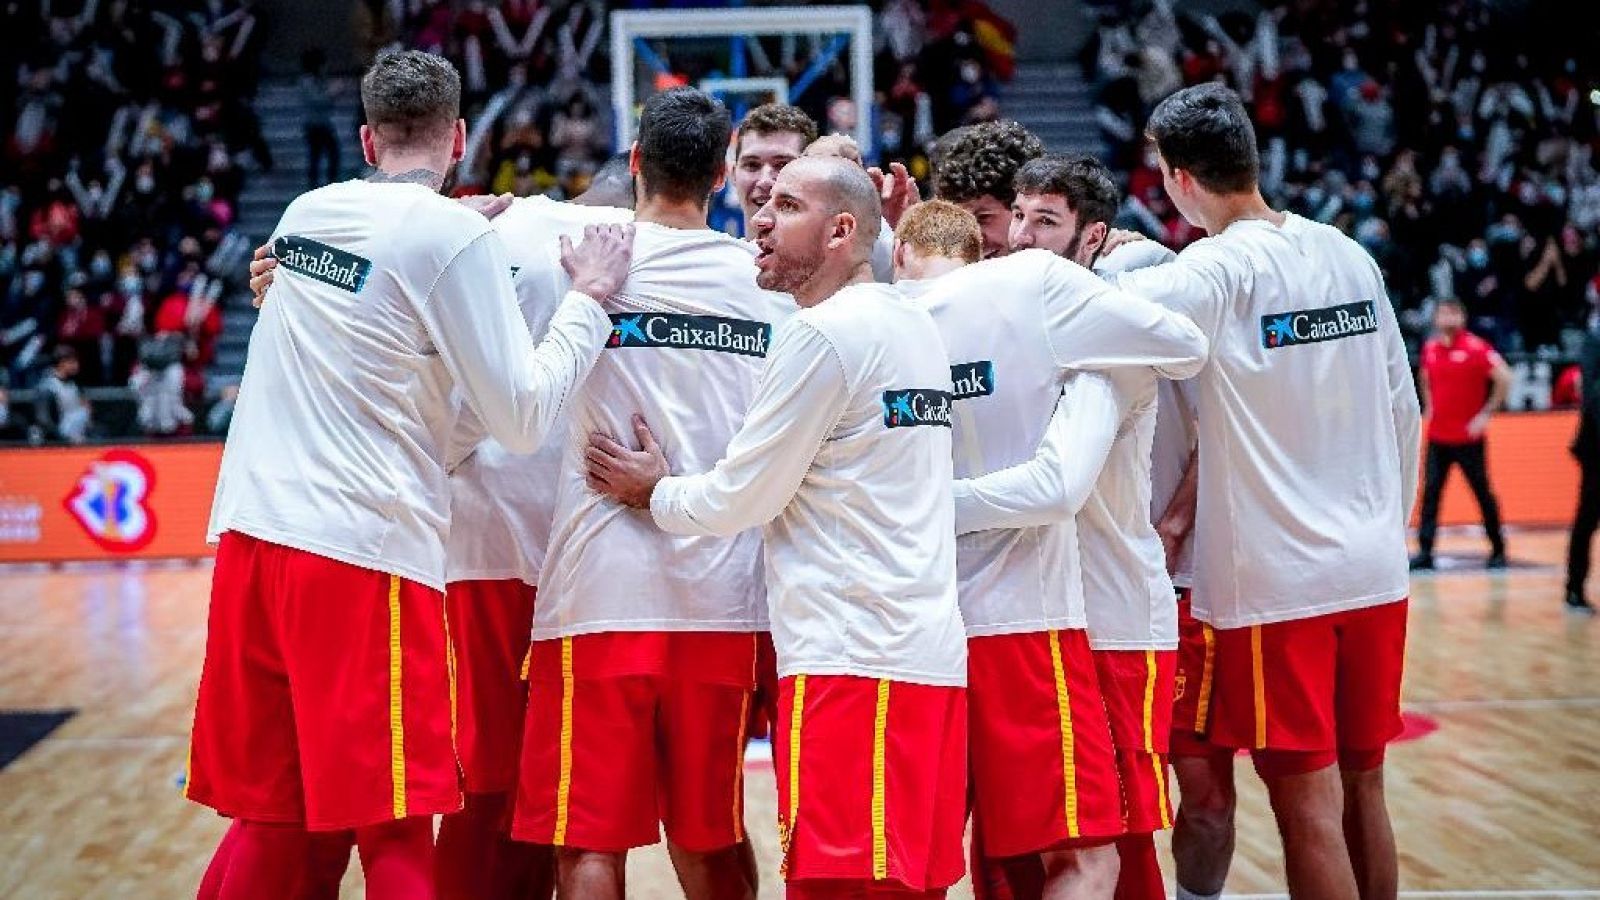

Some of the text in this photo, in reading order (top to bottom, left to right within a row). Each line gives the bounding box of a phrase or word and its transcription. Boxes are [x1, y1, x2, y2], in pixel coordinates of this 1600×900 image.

[273, 236, 360, 287] CaixaBank
[646, 316, 767, 353] CaixaBank
[1293, 305, 1378, 340] CaixaBank
